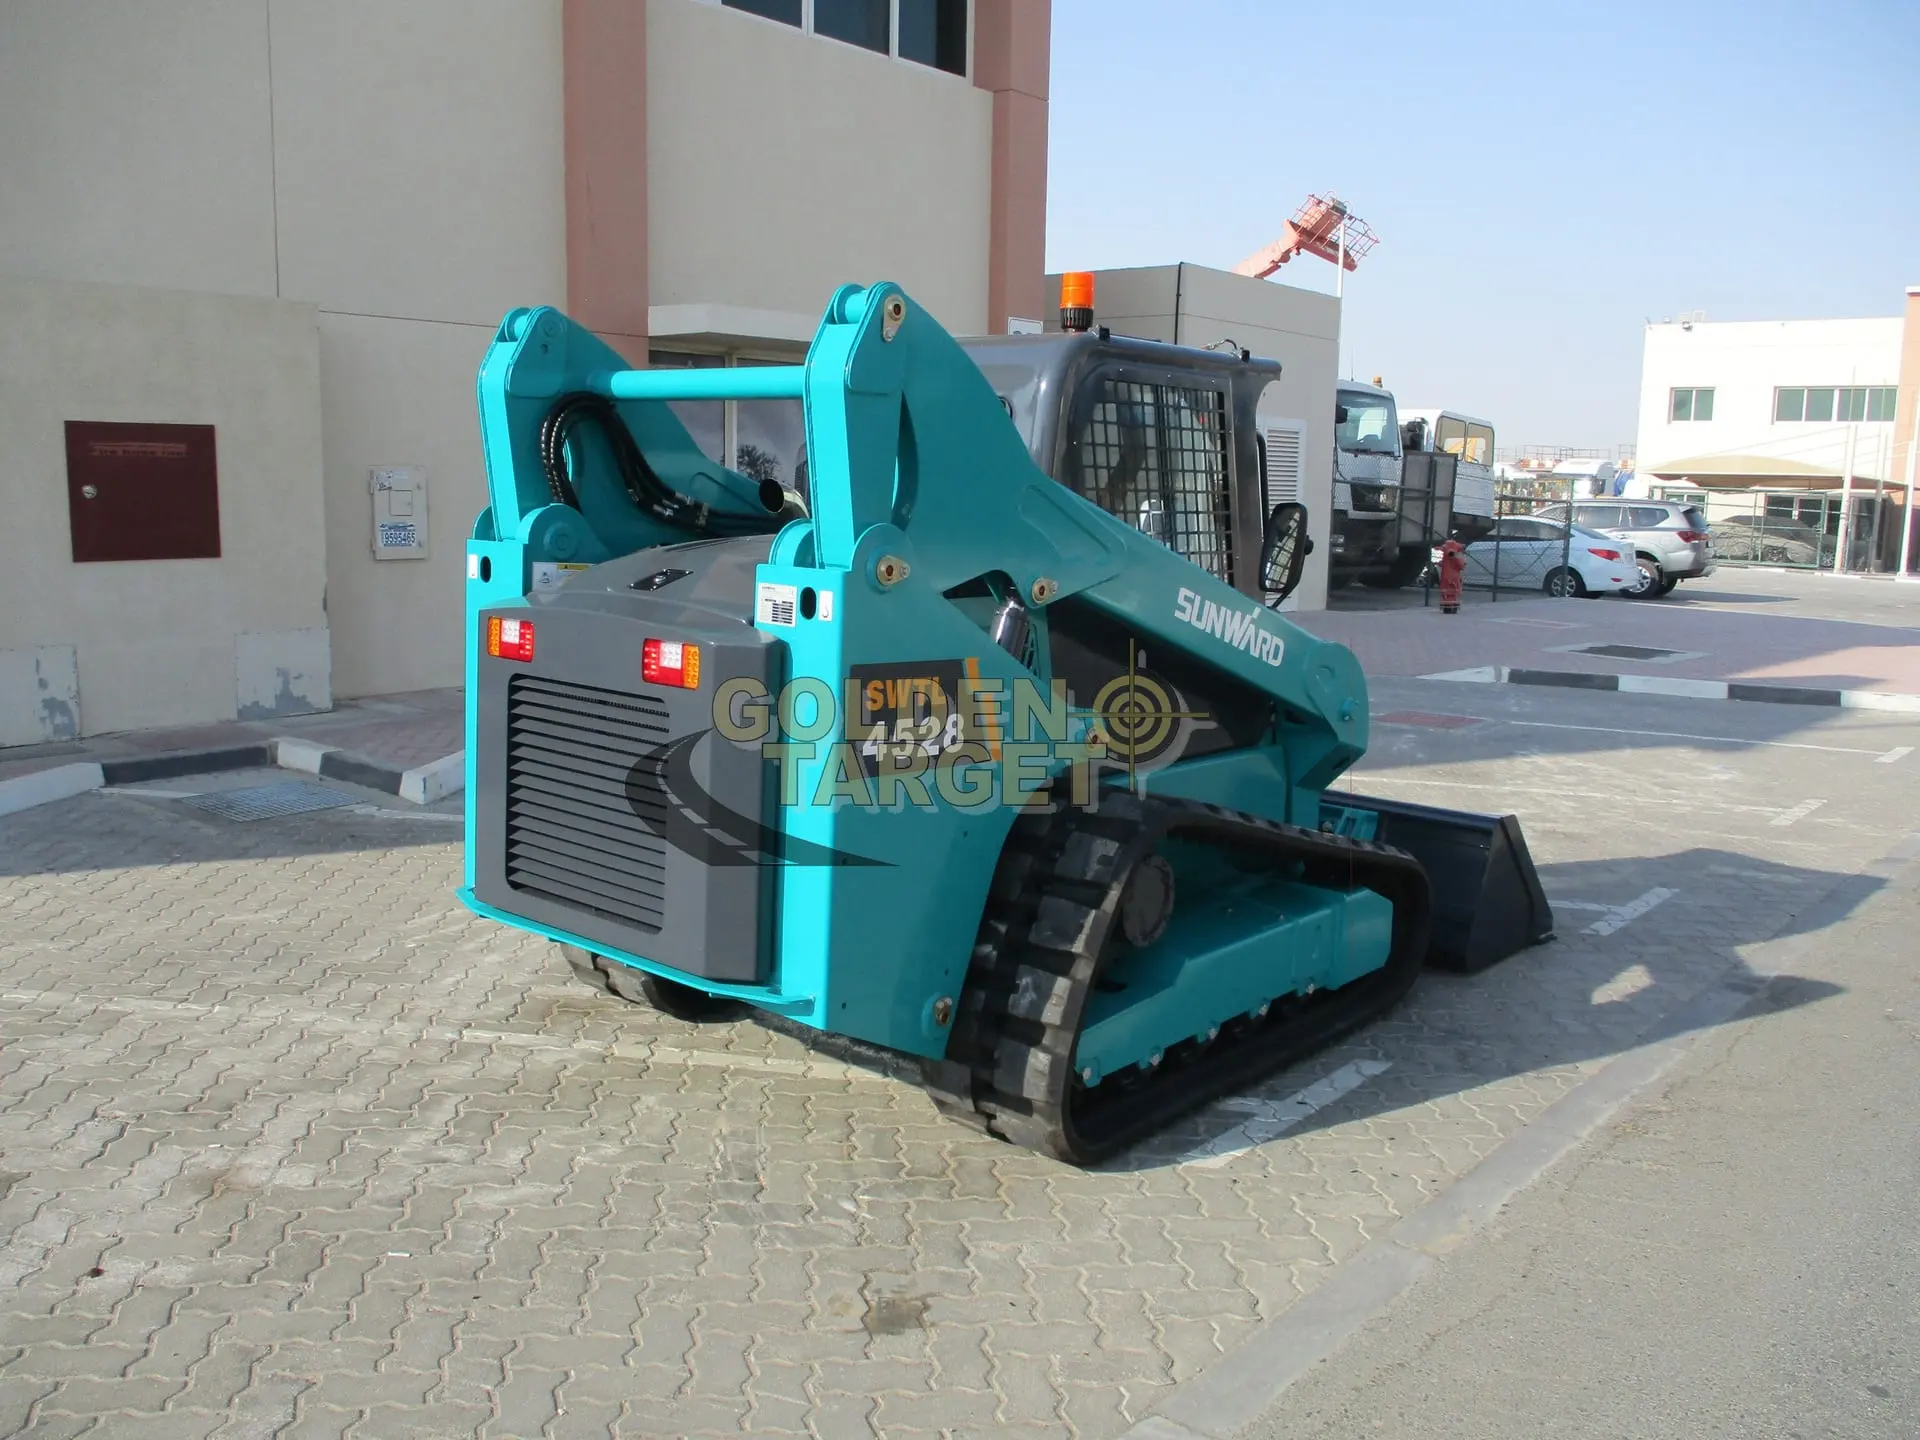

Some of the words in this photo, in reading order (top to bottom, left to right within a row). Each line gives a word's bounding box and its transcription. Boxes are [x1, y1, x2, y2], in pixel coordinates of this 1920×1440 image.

[1174, 587, 1285, 667] SUNWARD
[866, 676, 947, 711] SWTL
[862, 713, 965, 762] 4528
